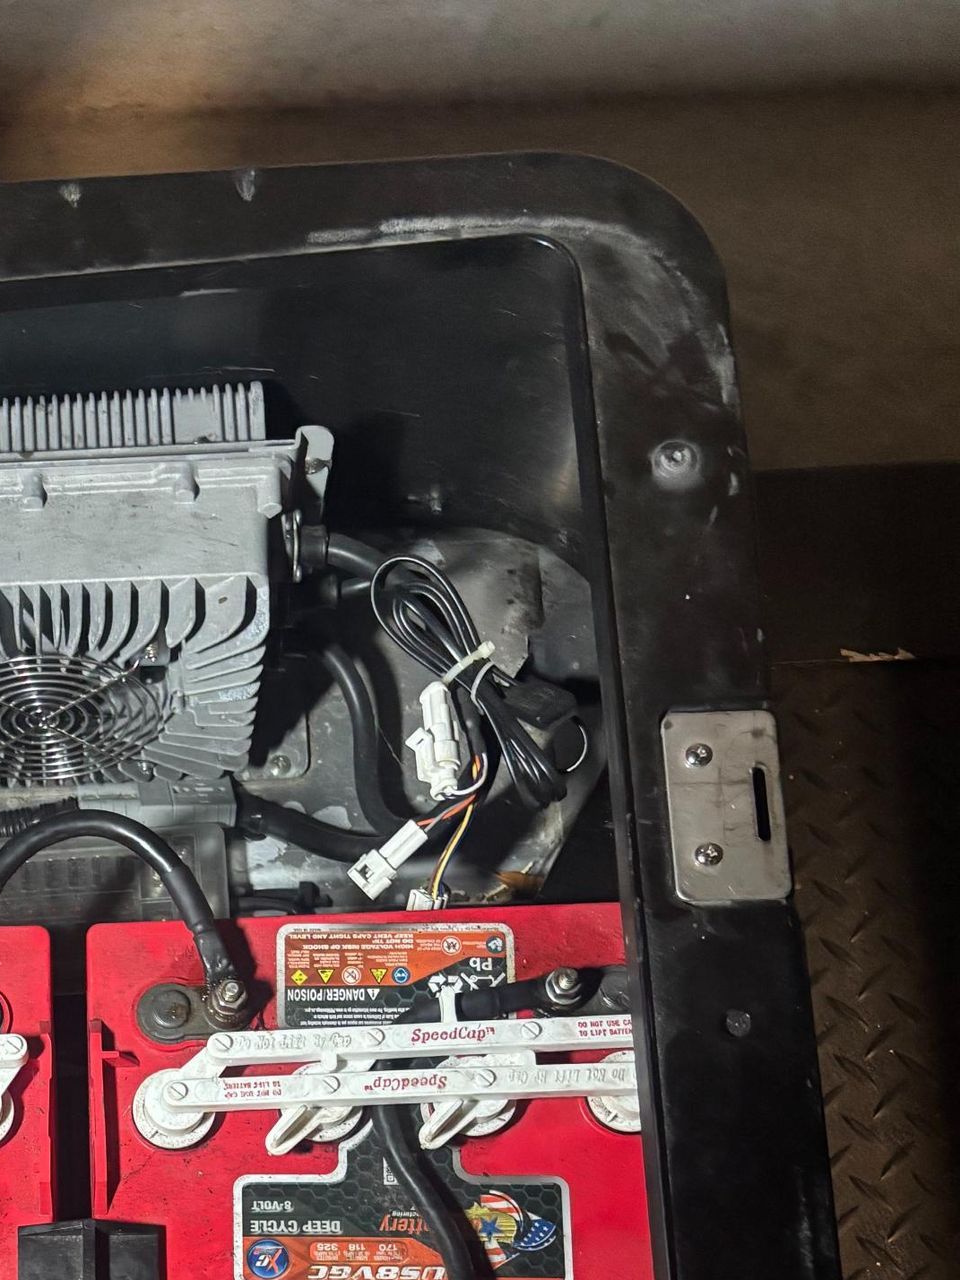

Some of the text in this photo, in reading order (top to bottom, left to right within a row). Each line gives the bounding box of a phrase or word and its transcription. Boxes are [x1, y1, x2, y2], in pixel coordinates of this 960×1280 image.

[469, 957, 493, 971] Pb
[287, 988, 365, 1001] DANGER/POISON
[251, 1199, 292, 1211] 8-VOLT
[250, 1219, 342, 1232] DEEP CYCLE
[379, 1215, 429, 1235] ttery
[316, 1243, 398, 1251] 170 118 325
[306, 1264, 446, 1280] US8VGC
